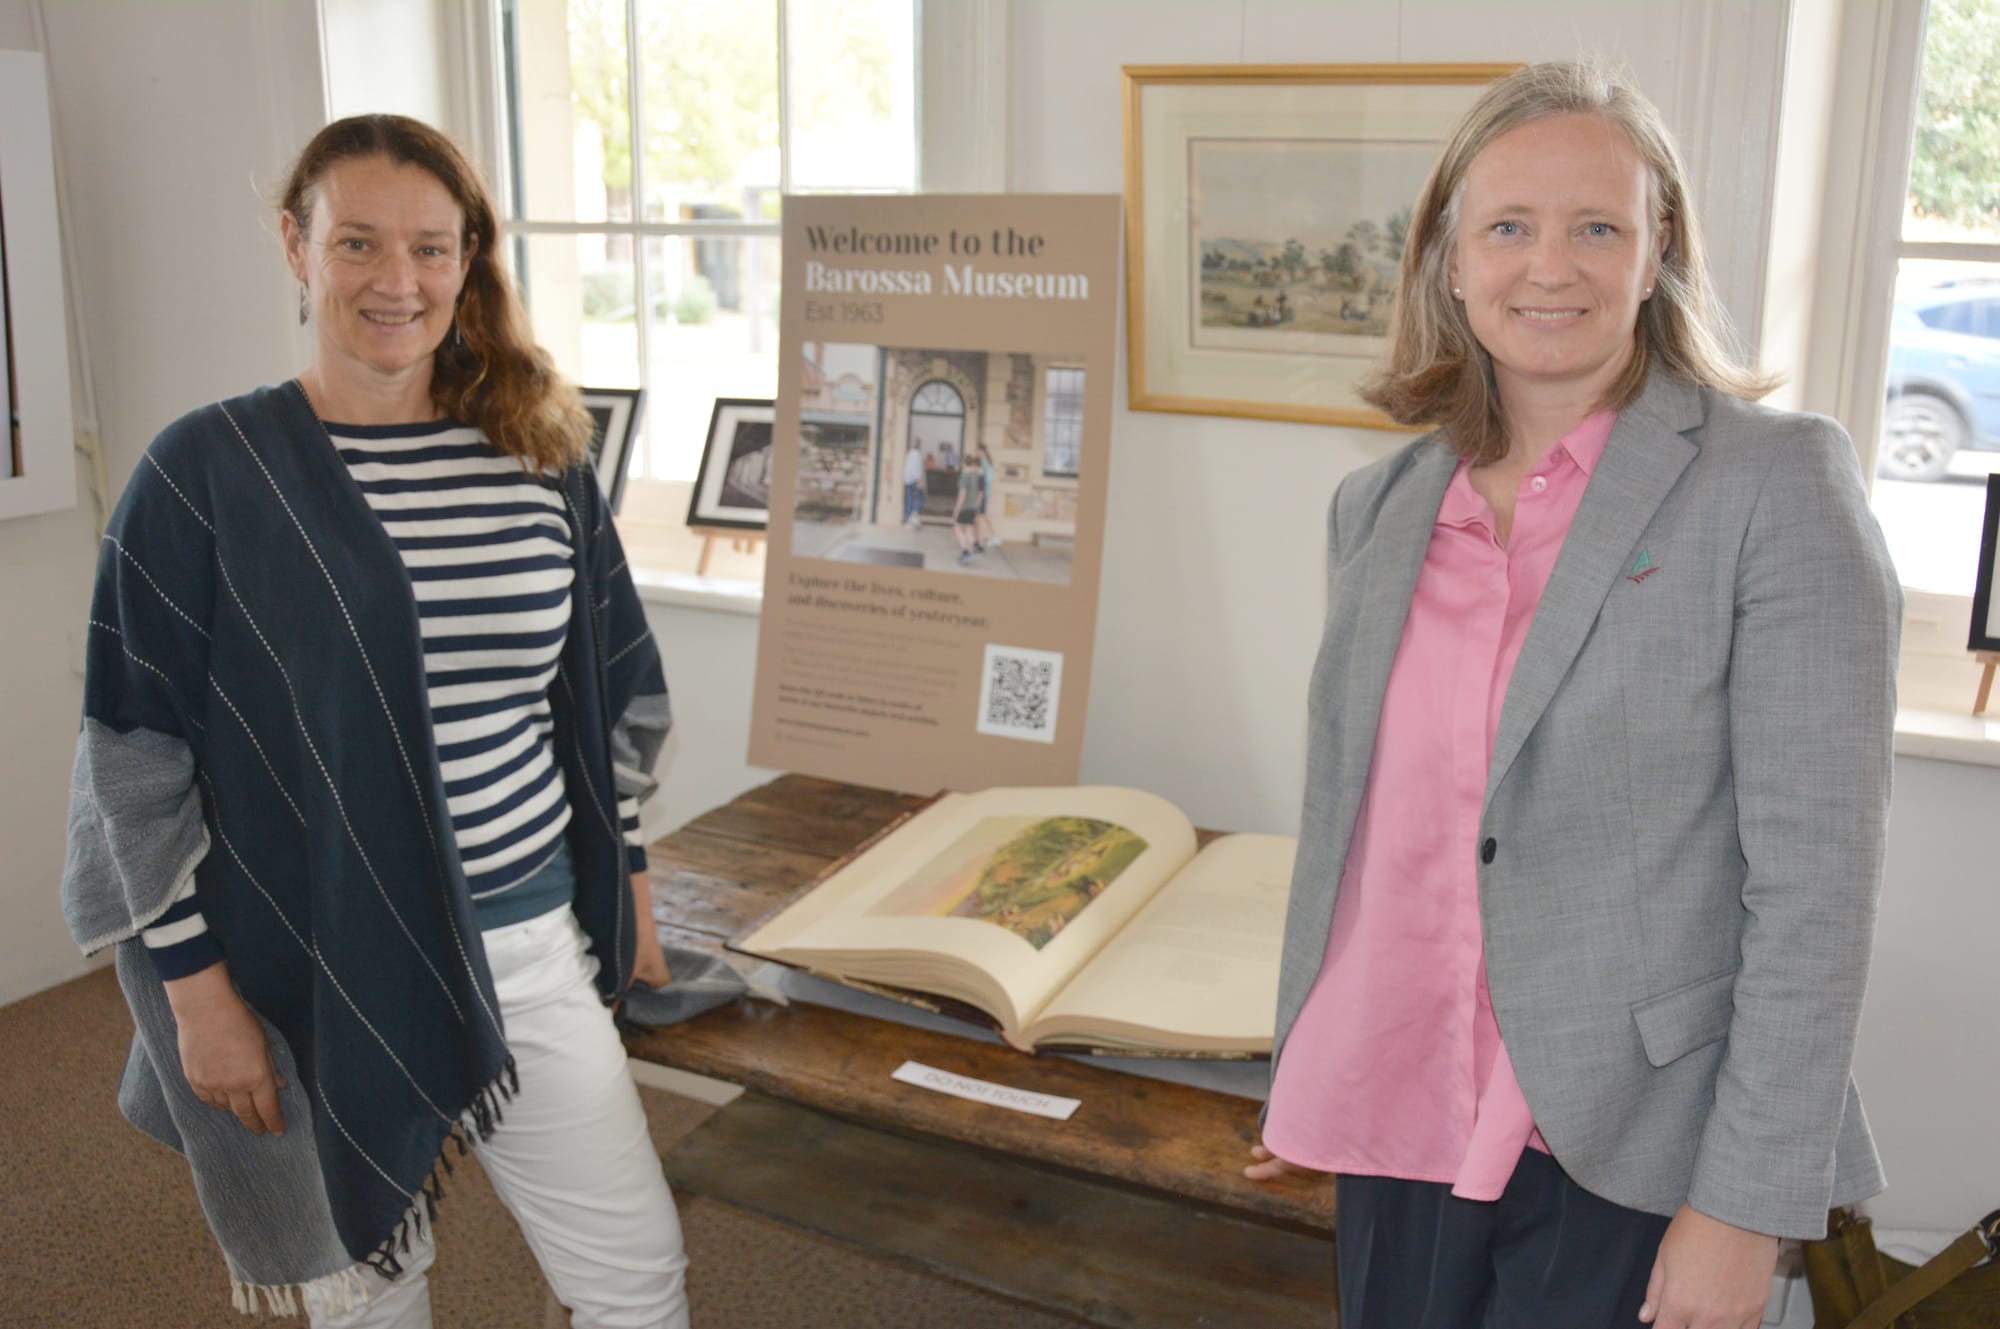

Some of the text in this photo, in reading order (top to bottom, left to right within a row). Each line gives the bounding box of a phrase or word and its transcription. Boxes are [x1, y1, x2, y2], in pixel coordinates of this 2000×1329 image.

[806, 225, 1045, 257] Welcome to the
[805, 260, 1089, 299] Barossa Museum
[805, 301, 884, 323] Est 1963
[844, 578, 866, 592] the
[787, 594, 812, 605] and
[891, 604, 907, 617] of
[925, 1071, 1050, 1108] DO NOT TOUCH
